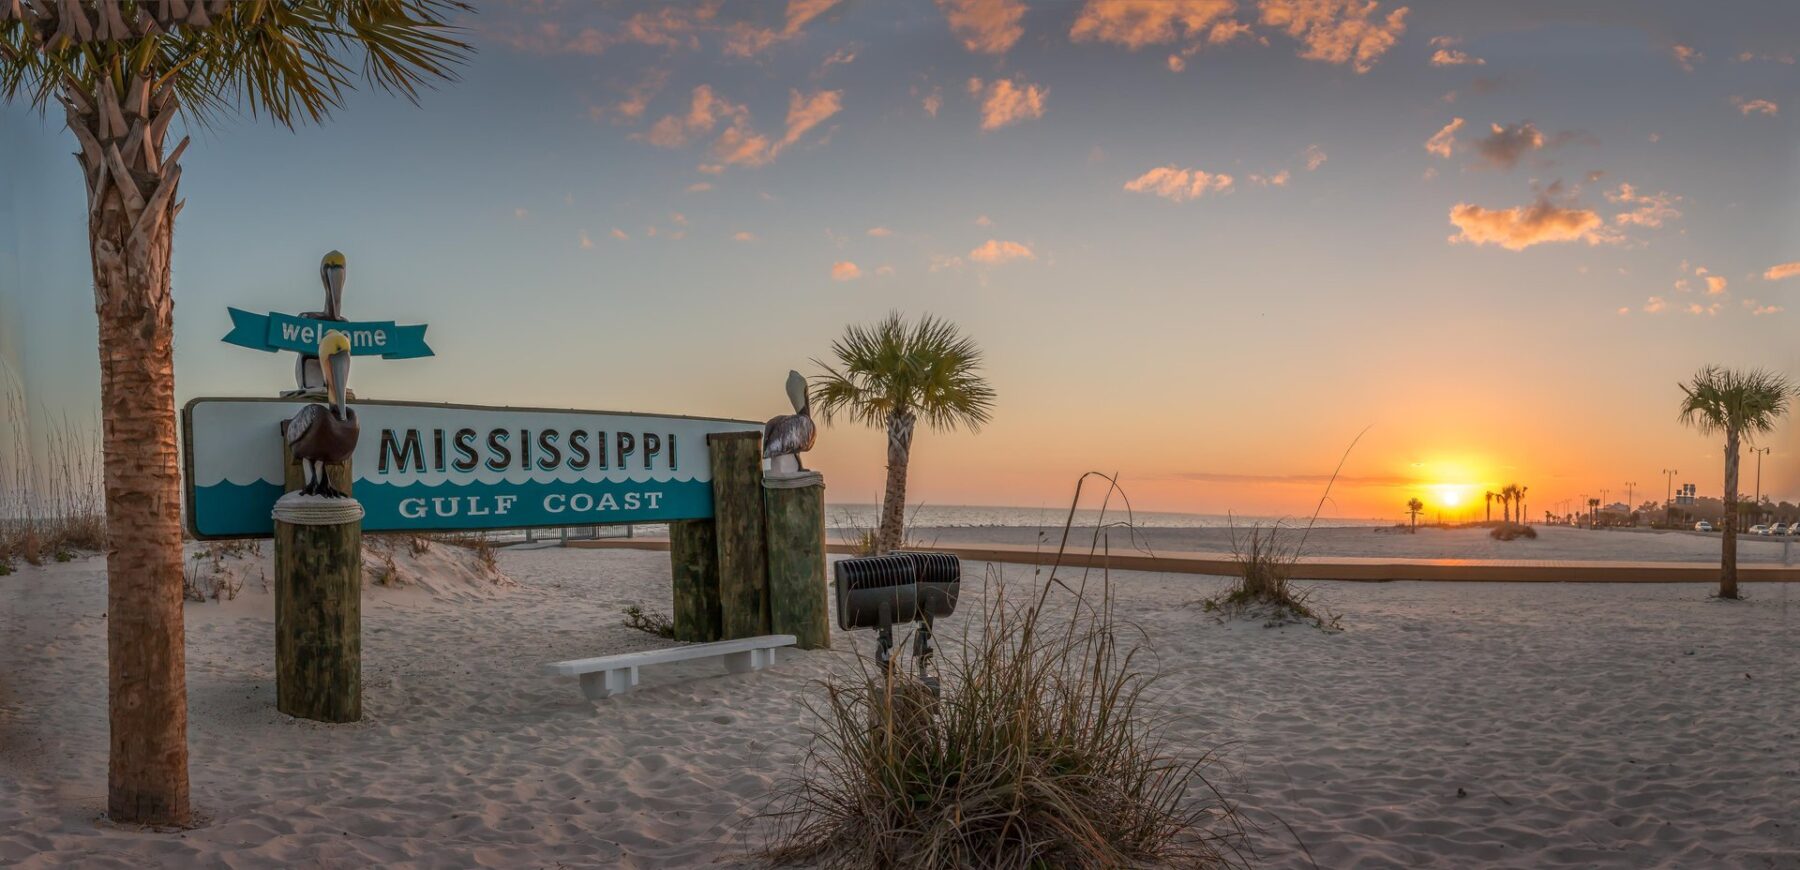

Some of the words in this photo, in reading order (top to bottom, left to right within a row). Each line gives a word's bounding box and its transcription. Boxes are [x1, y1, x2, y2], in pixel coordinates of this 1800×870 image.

[282, 322, 387, 347] welme
[378, 428, 678, 474] MISSISSIPPI
[398, 495, 518, 518] GULF
[543, 491, 663, 513] COAST
